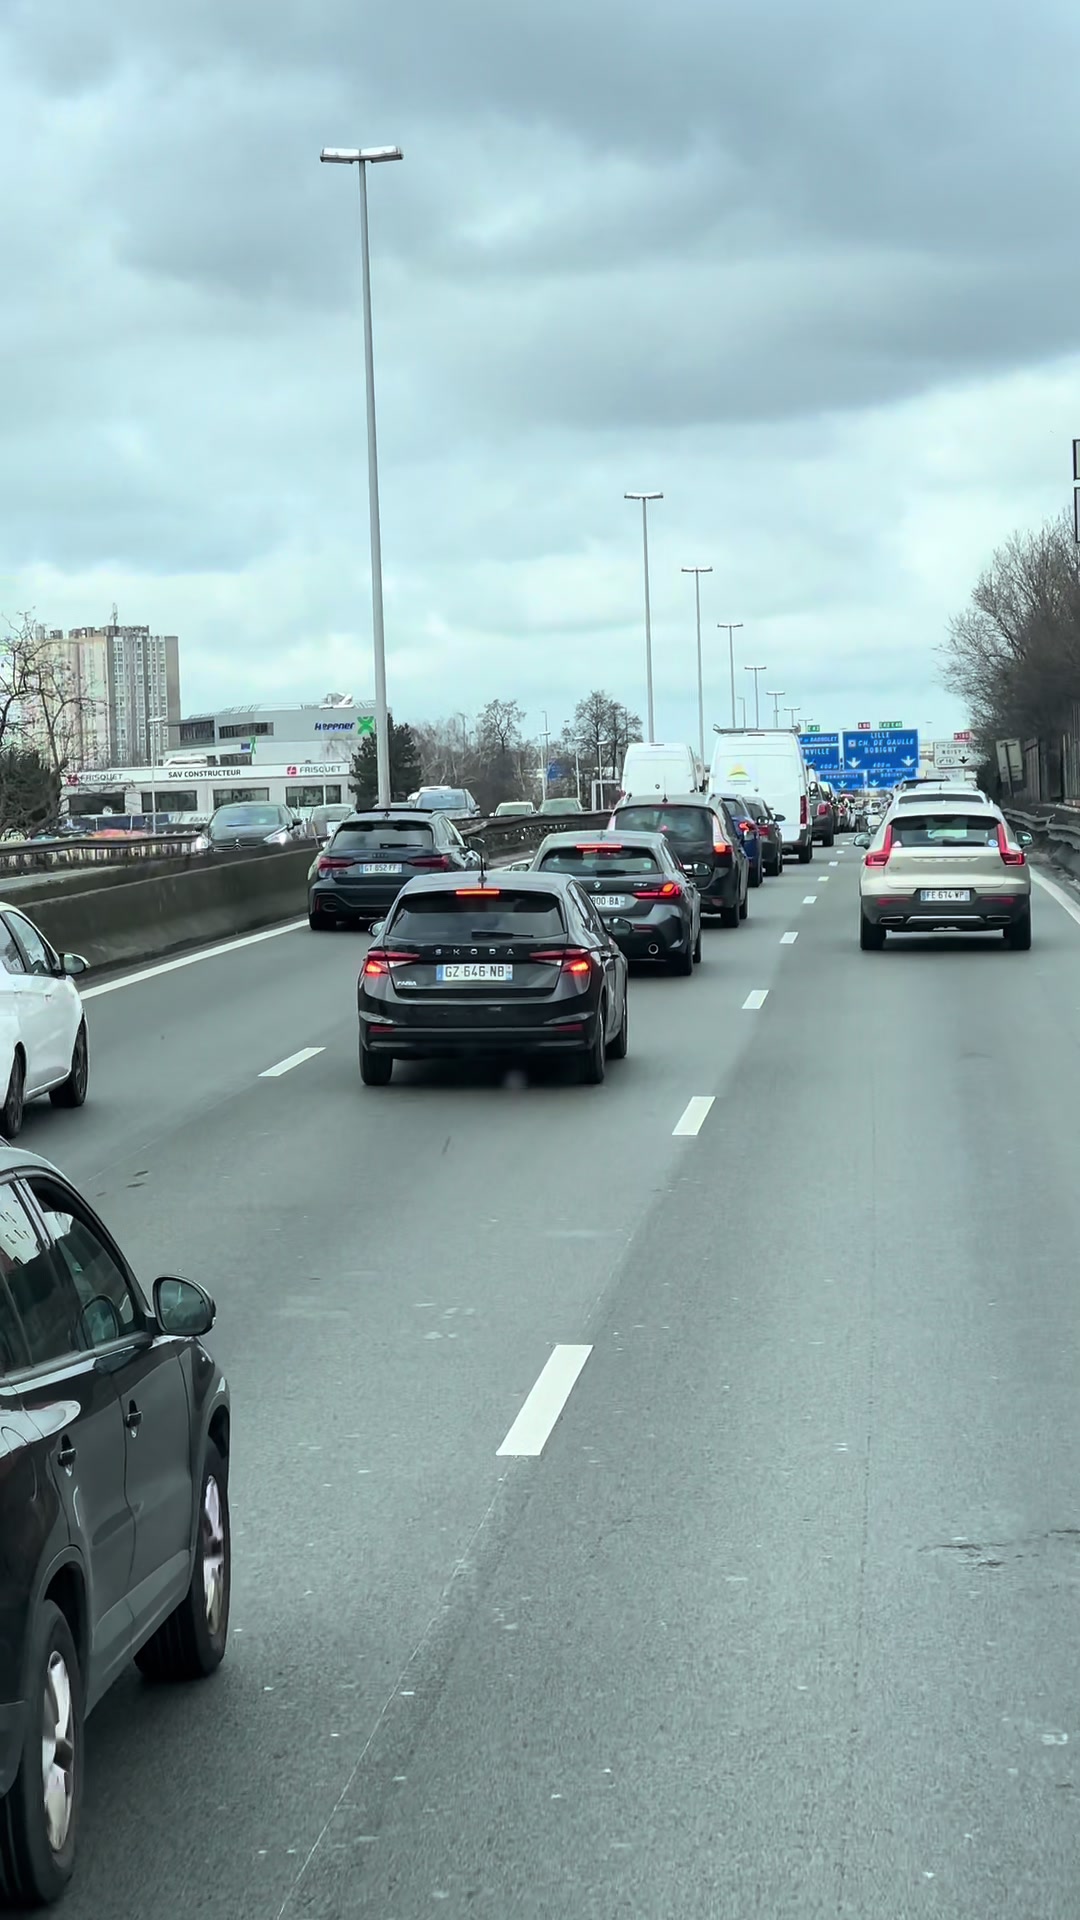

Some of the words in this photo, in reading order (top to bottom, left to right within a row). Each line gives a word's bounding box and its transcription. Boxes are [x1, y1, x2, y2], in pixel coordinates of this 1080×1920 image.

[314, 722, 355, 730] Heppner
[864, 746, 897, 754] BOBIGNY
[184, 769, 241, 777] CONSTRUCTEUR
[300, 765, 342, 773] FRISQUET
[81, 773, 123, 781] FRISQUET
